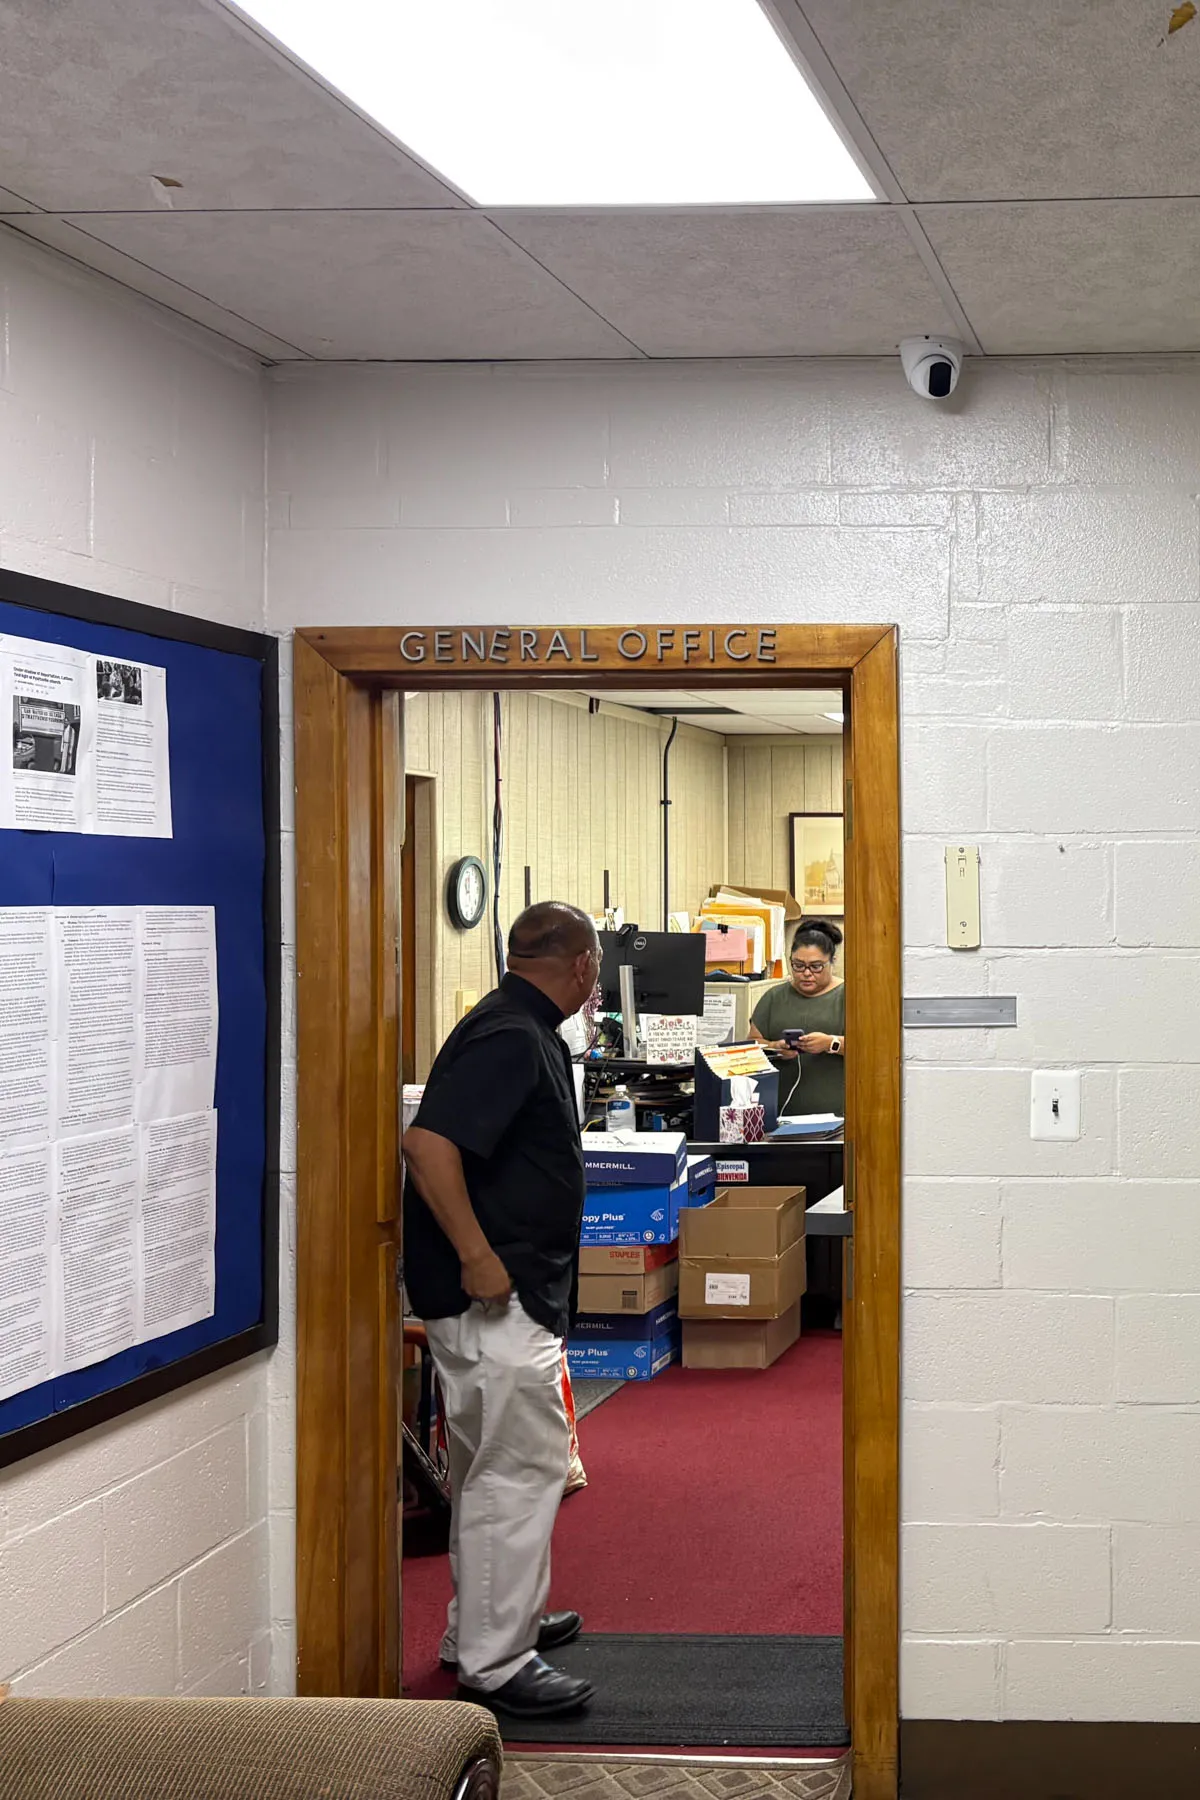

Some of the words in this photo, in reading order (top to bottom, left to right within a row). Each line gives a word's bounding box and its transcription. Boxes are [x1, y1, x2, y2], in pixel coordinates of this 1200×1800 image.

[400, 630, 599, 662] GENERAL
[617, 629, 777, 662] OFFICE
[585, 1162, 633, 1170] MMERMILL
[716, 1162, 745, 1171] Episcopal
[582, 1215, 600, 1223] opy
